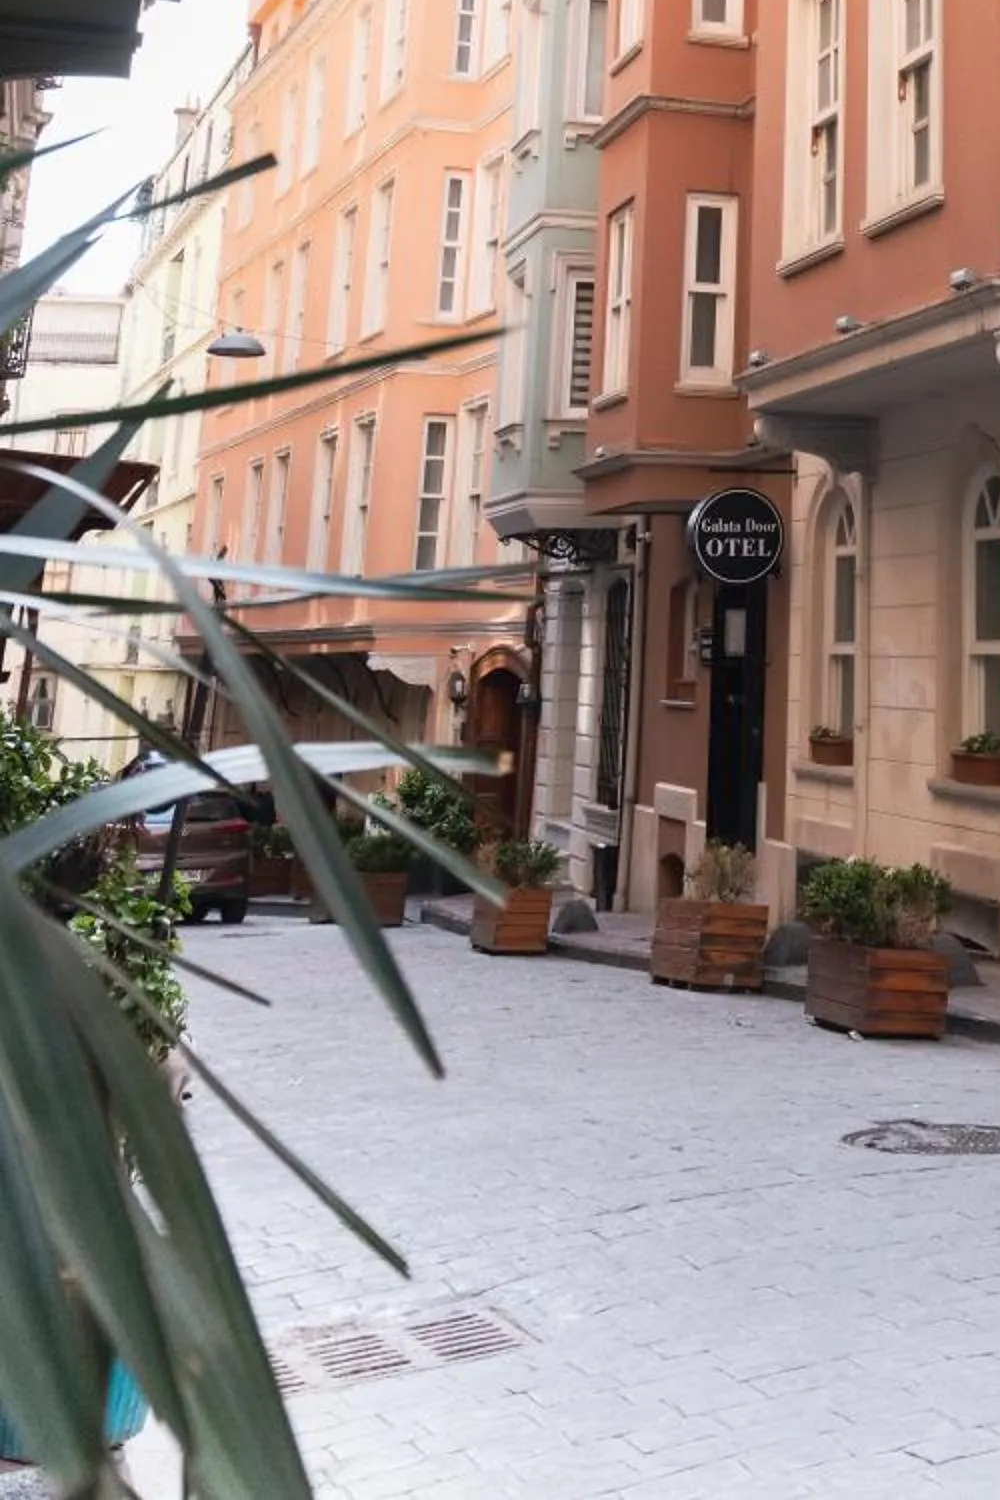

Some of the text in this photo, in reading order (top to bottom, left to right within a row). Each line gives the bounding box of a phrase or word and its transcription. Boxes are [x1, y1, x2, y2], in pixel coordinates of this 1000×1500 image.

[701, 517, 777, 533] Galata Door
[705, 537, 772, 557] OTEL
